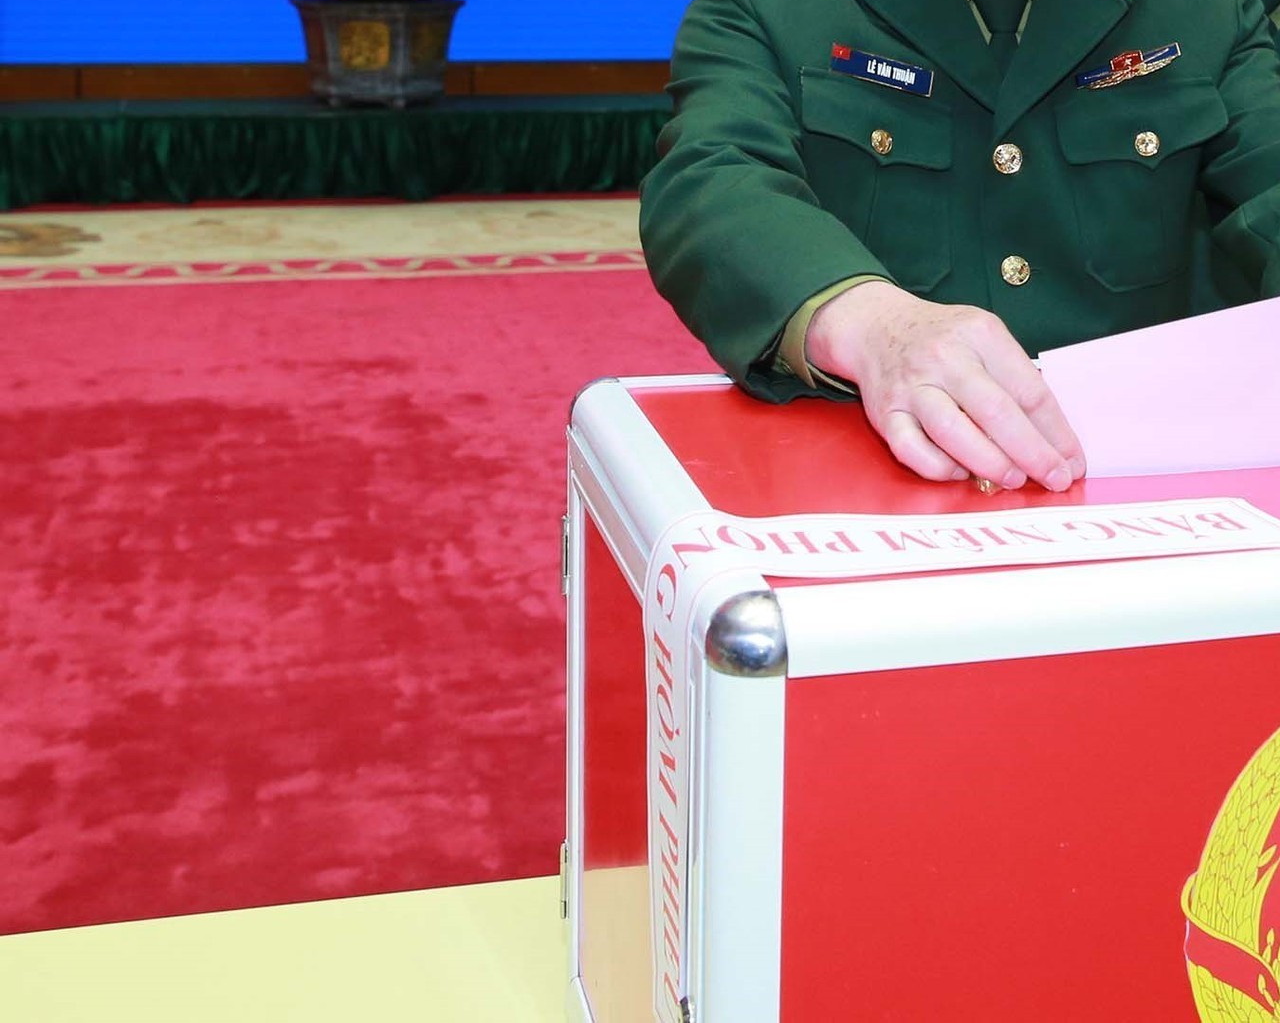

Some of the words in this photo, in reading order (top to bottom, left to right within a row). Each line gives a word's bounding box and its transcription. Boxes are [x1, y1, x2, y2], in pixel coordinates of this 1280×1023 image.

[867, 59, 877, 74] LÊ
[873, 524, 1056, 553] NIÊM
[1062, 511, 1248, 541] BĂNG
[656, 524, 863, 622] PHONG
